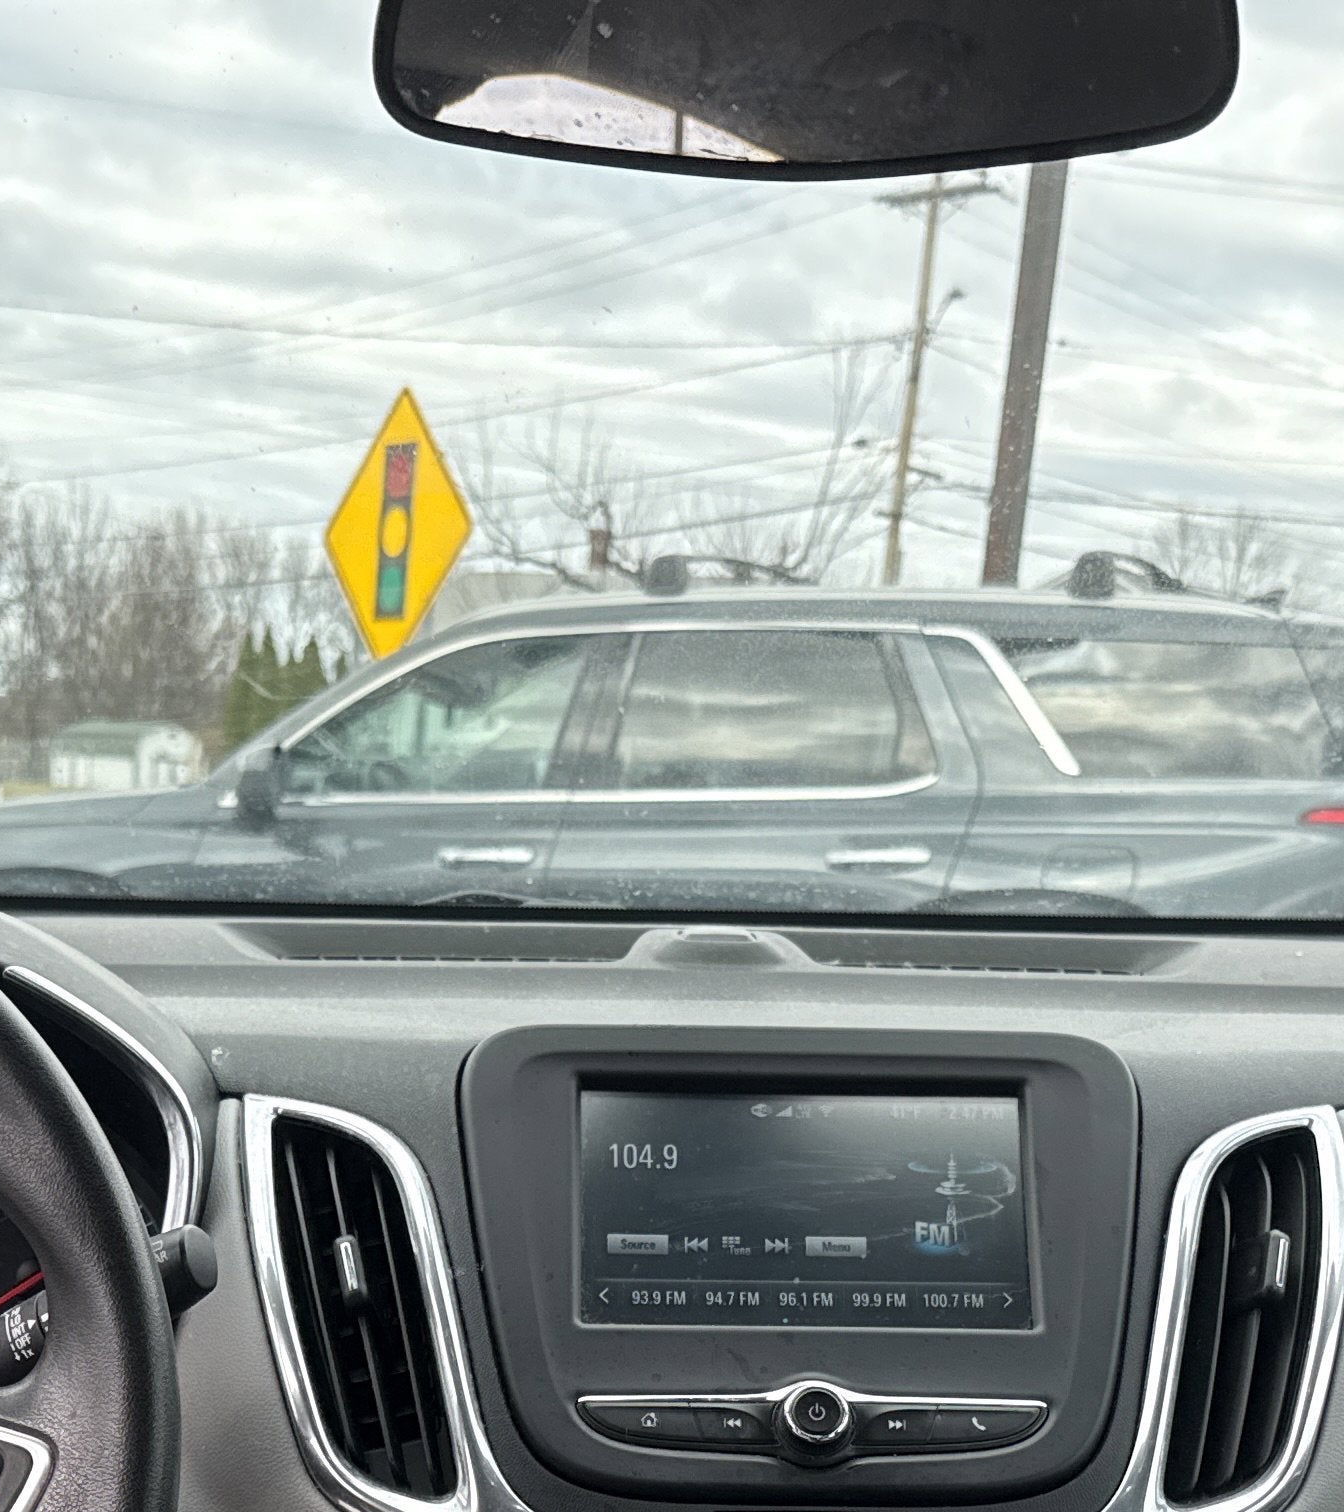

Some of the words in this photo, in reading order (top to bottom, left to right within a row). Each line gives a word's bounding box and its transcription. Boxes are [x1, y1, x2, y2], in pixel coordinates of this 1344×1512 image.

[608, 1143, 678, 1170] 104.9
[914, 1220, 953, 1247] FM
[620, 1238, 657, 1251] Source
[631, 1290, 662, 1306] 93.9
[665, 1290, 687, 1306] FM
[705, 1291, 735, 1306] 94.7
[739, 1291, 760, 1306] FM
[778, 1292, 808, 1308] 96.1
[812, 1292, 834, 1308] FM
[852, 1292, 882, 1308] 99.9
[885, 1292, 907, 1308] FM
[923, 1293, 959, 1309] 100.7
[963, 1293, 985, 1309] FM
[14, 1332, 32, 1350] OFF
